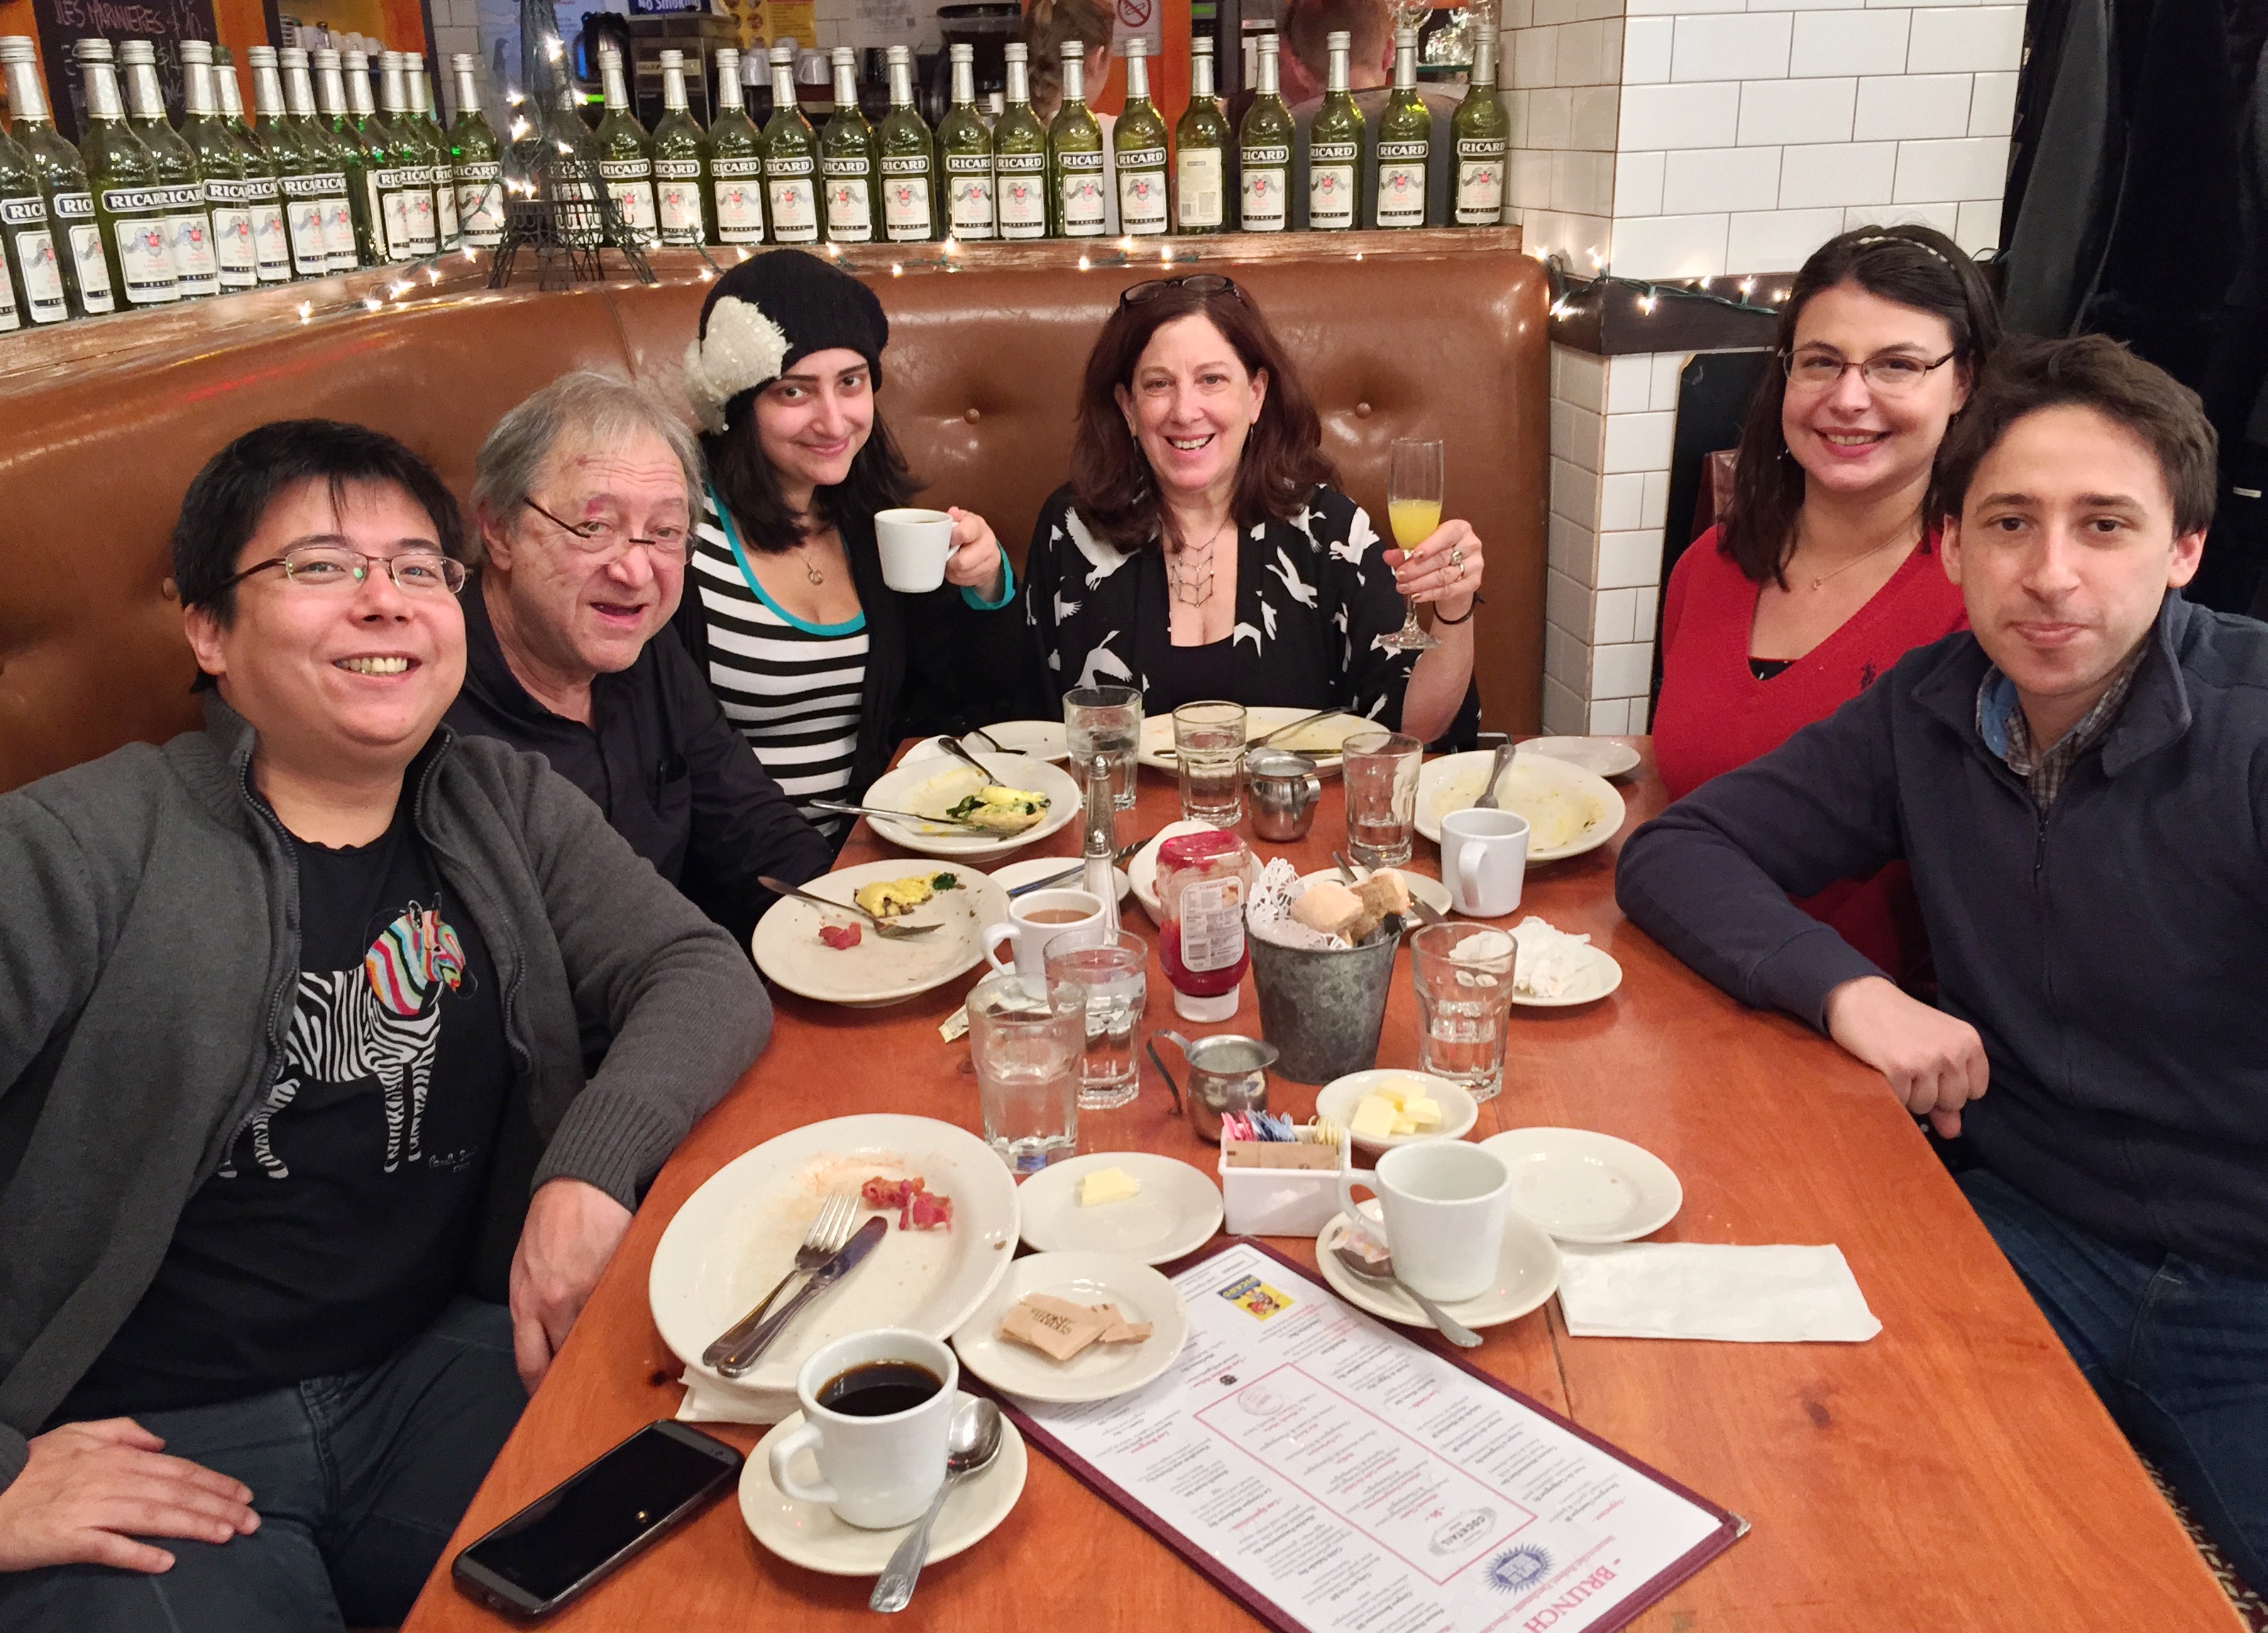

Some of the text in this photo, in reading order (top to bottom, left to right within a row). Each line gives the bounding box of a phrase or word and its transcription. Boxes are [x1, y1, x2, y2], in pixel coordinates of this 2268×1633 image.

[1380, 145, 1425, 155] RICARD
[1462, 142, 1505, 153] RICARD
[1119, 152, 1162, 164] RICARD
[1242, 150, 1285, 160] RICARD
[712, 162, 756, 172] RICARD
[767, 161, 810, 172] RICARD
[882, 160, 926, 170] RICARD
[998, 158, 1042, 167] RICARD
[602, 163, 648, 175] RICARD
[109, 192, 160, 208] RICAR
[160, 189, 204, 204] RICAR
[1441, 1515, 1486, 1546] COCKTAIL
[1522, 1565, 1617, 1633] BRUNCH
